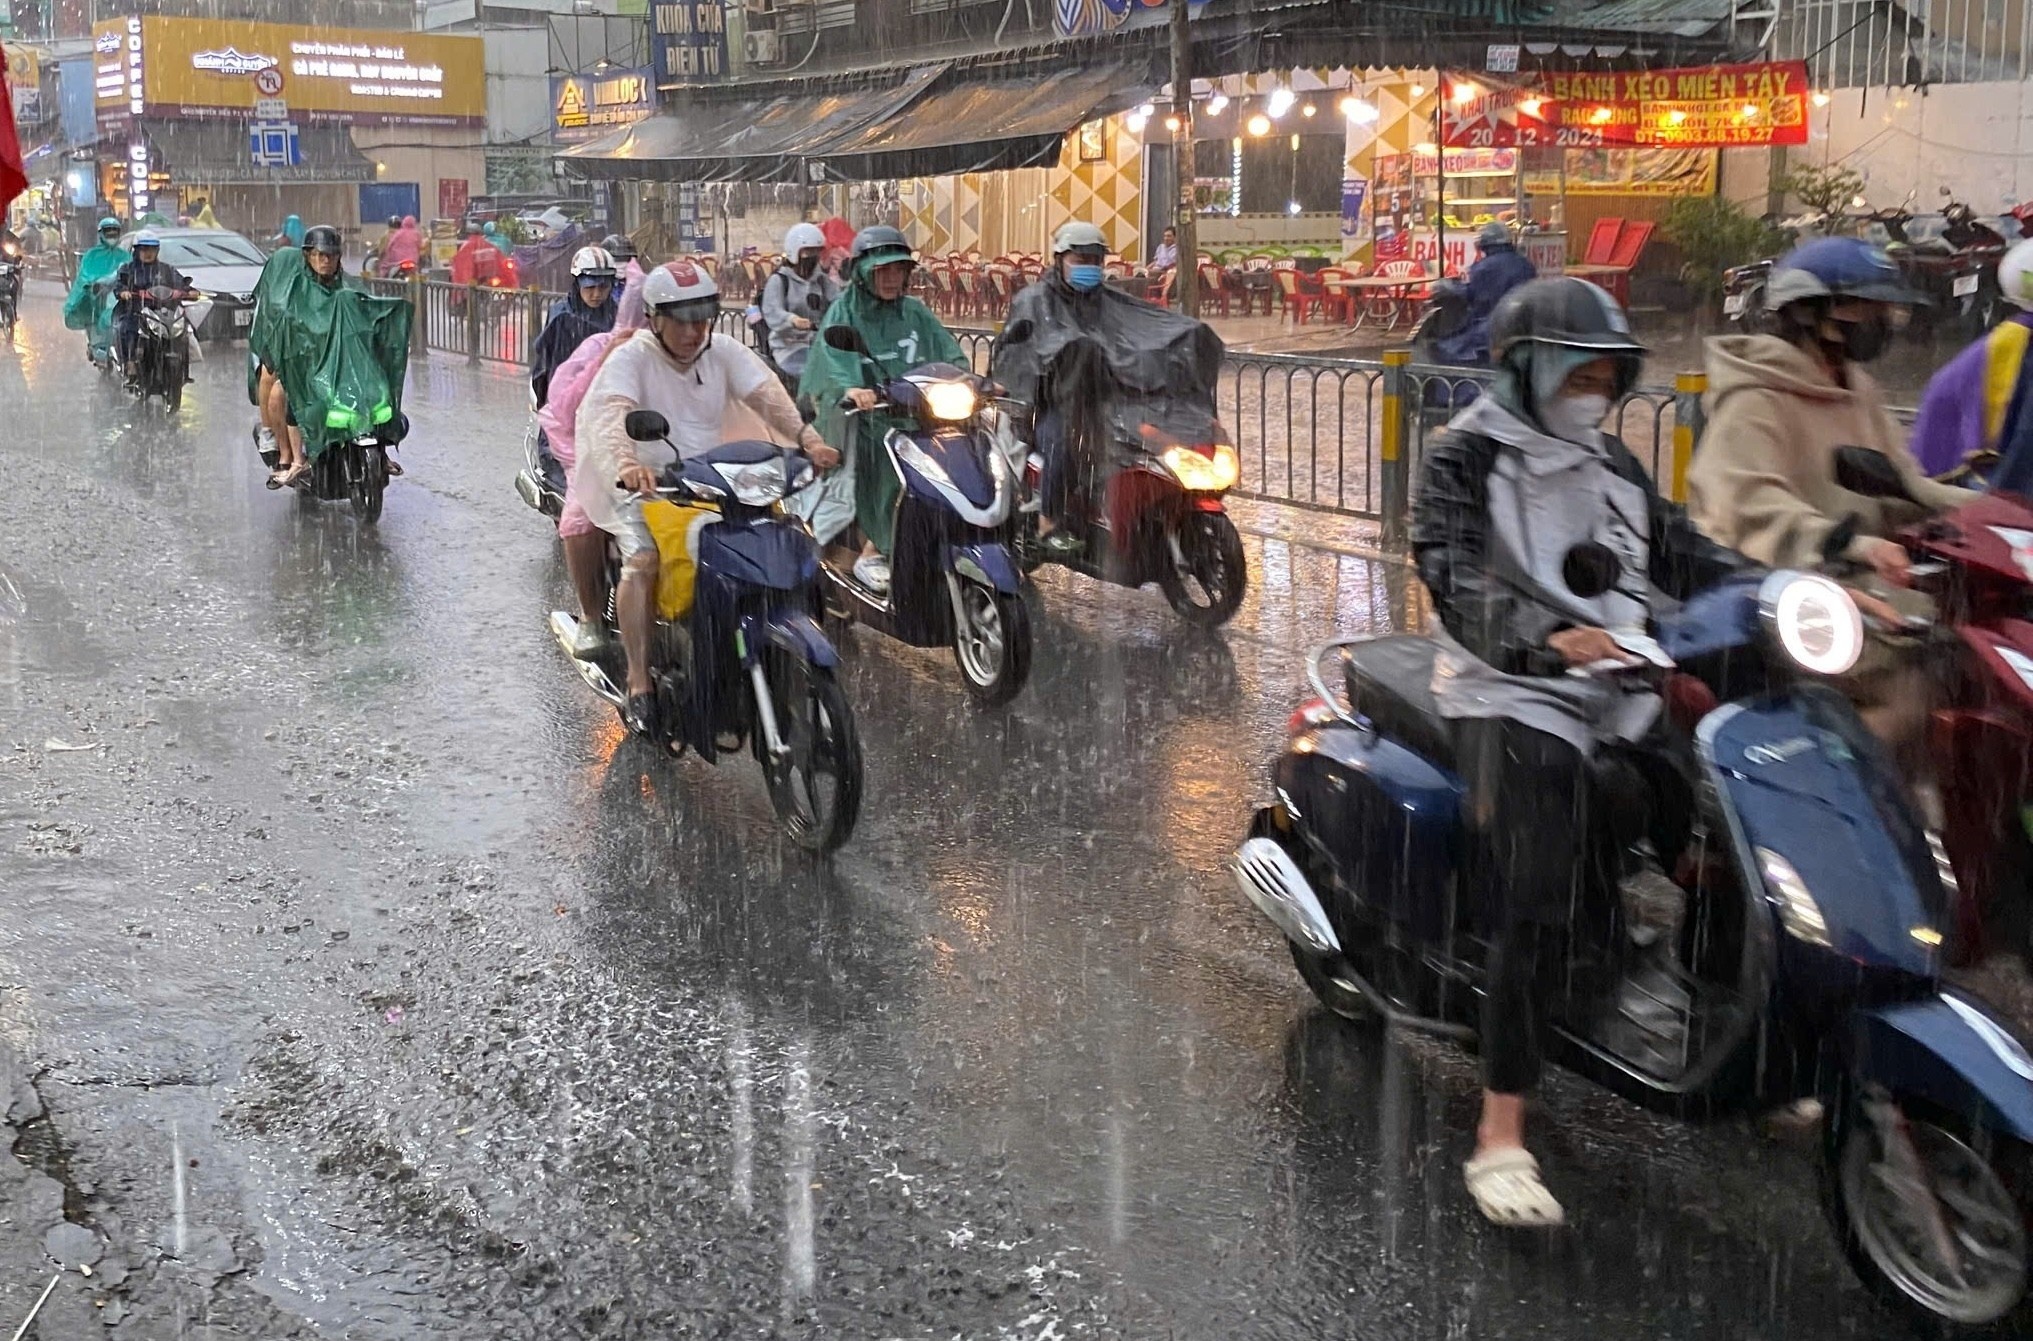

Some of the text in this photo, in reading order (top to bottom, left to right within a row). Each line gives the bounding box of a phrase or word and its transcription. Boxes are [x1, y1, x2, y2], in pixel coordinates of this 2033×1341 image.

[656, 0, 723, 34] KHÓA CỬA
[128, 15, 143, 114] COFFEE
[666, 40, 699, 81] ĐIỆN
[1554, 65, 1791, 101] BÁNH XÈO MIỀN TÂY
[1470, 128, 1493, 146] 20
[1514, 128, 1537, 146] 12
[1556, 127, 1604, 146] 2024
[1415, 234, 1465, 266] BÁNH
